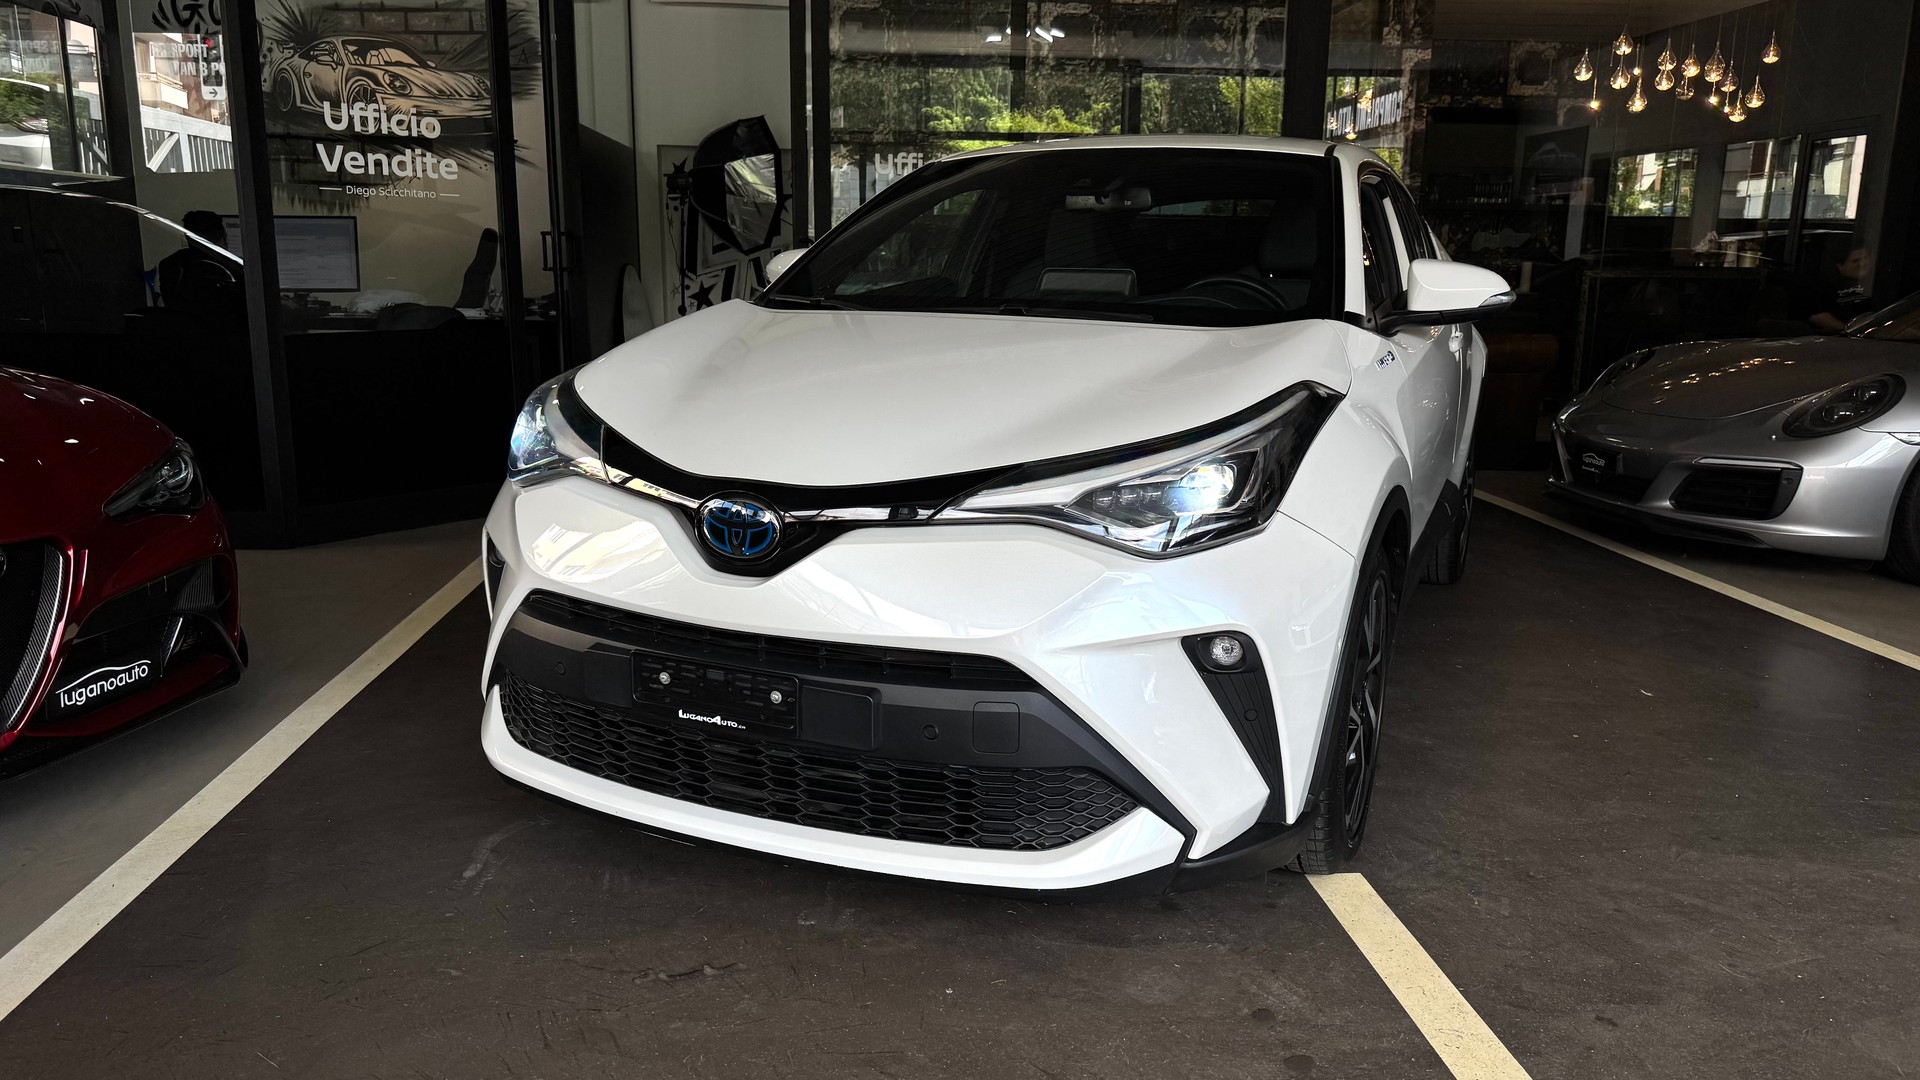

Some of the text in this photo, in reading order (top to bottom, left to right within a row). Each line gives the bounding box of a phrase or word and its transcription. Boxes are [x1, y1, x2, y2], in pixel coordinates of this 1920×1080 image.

[323, 100, 442, 139] Ufficio
[315, 143, 459, 180] Vendite
[346, 185, 437, 199] Diego Scicchitano
[60, 665, 149, 708] luganoauto
